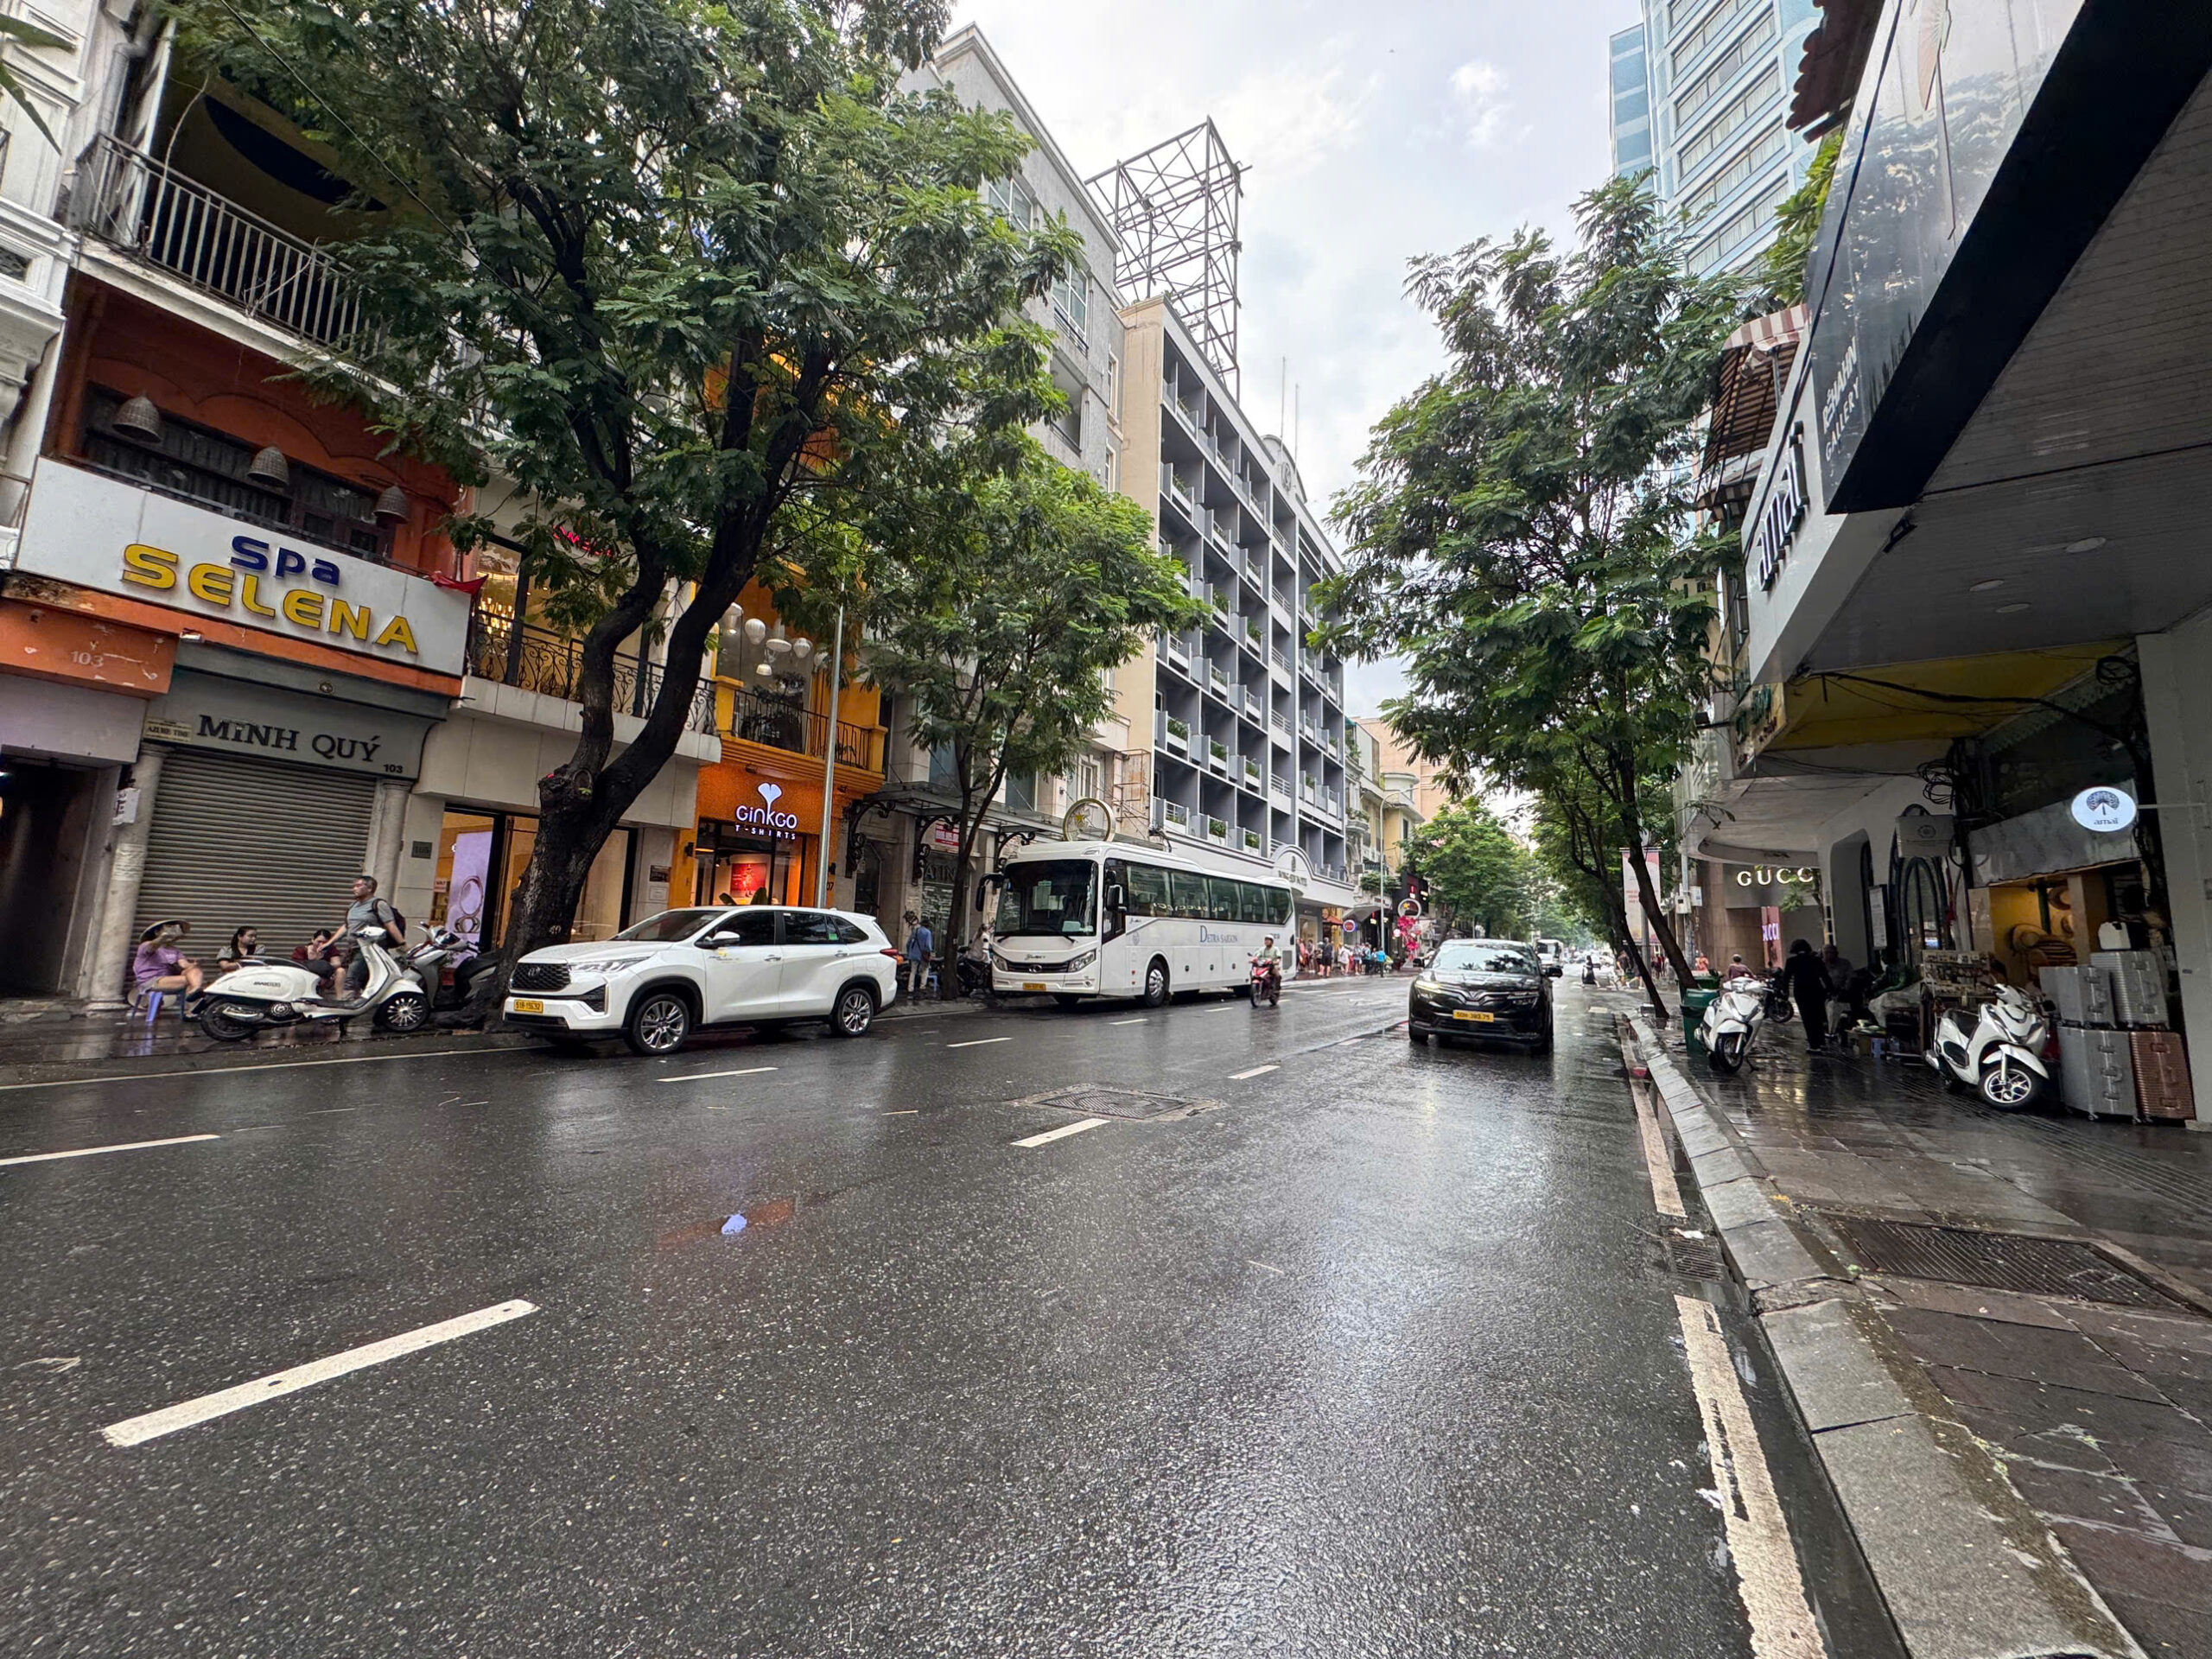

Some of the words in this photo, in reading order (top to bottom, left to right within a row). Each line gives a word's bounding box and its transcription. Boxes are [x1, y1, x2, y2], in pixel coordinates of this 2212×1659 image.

[1825, 377, 1859, 461] GALLERY
[120, 543, 418, 654] SELENA
[71, 651, 104, 667] 103
[312, 734, 381, 762] QUÝ
[383, 764, 404, 773] 103
[735, 825, 796, 840] T-SHIRTS
[1737, 868, 1815, 887] GUCC
